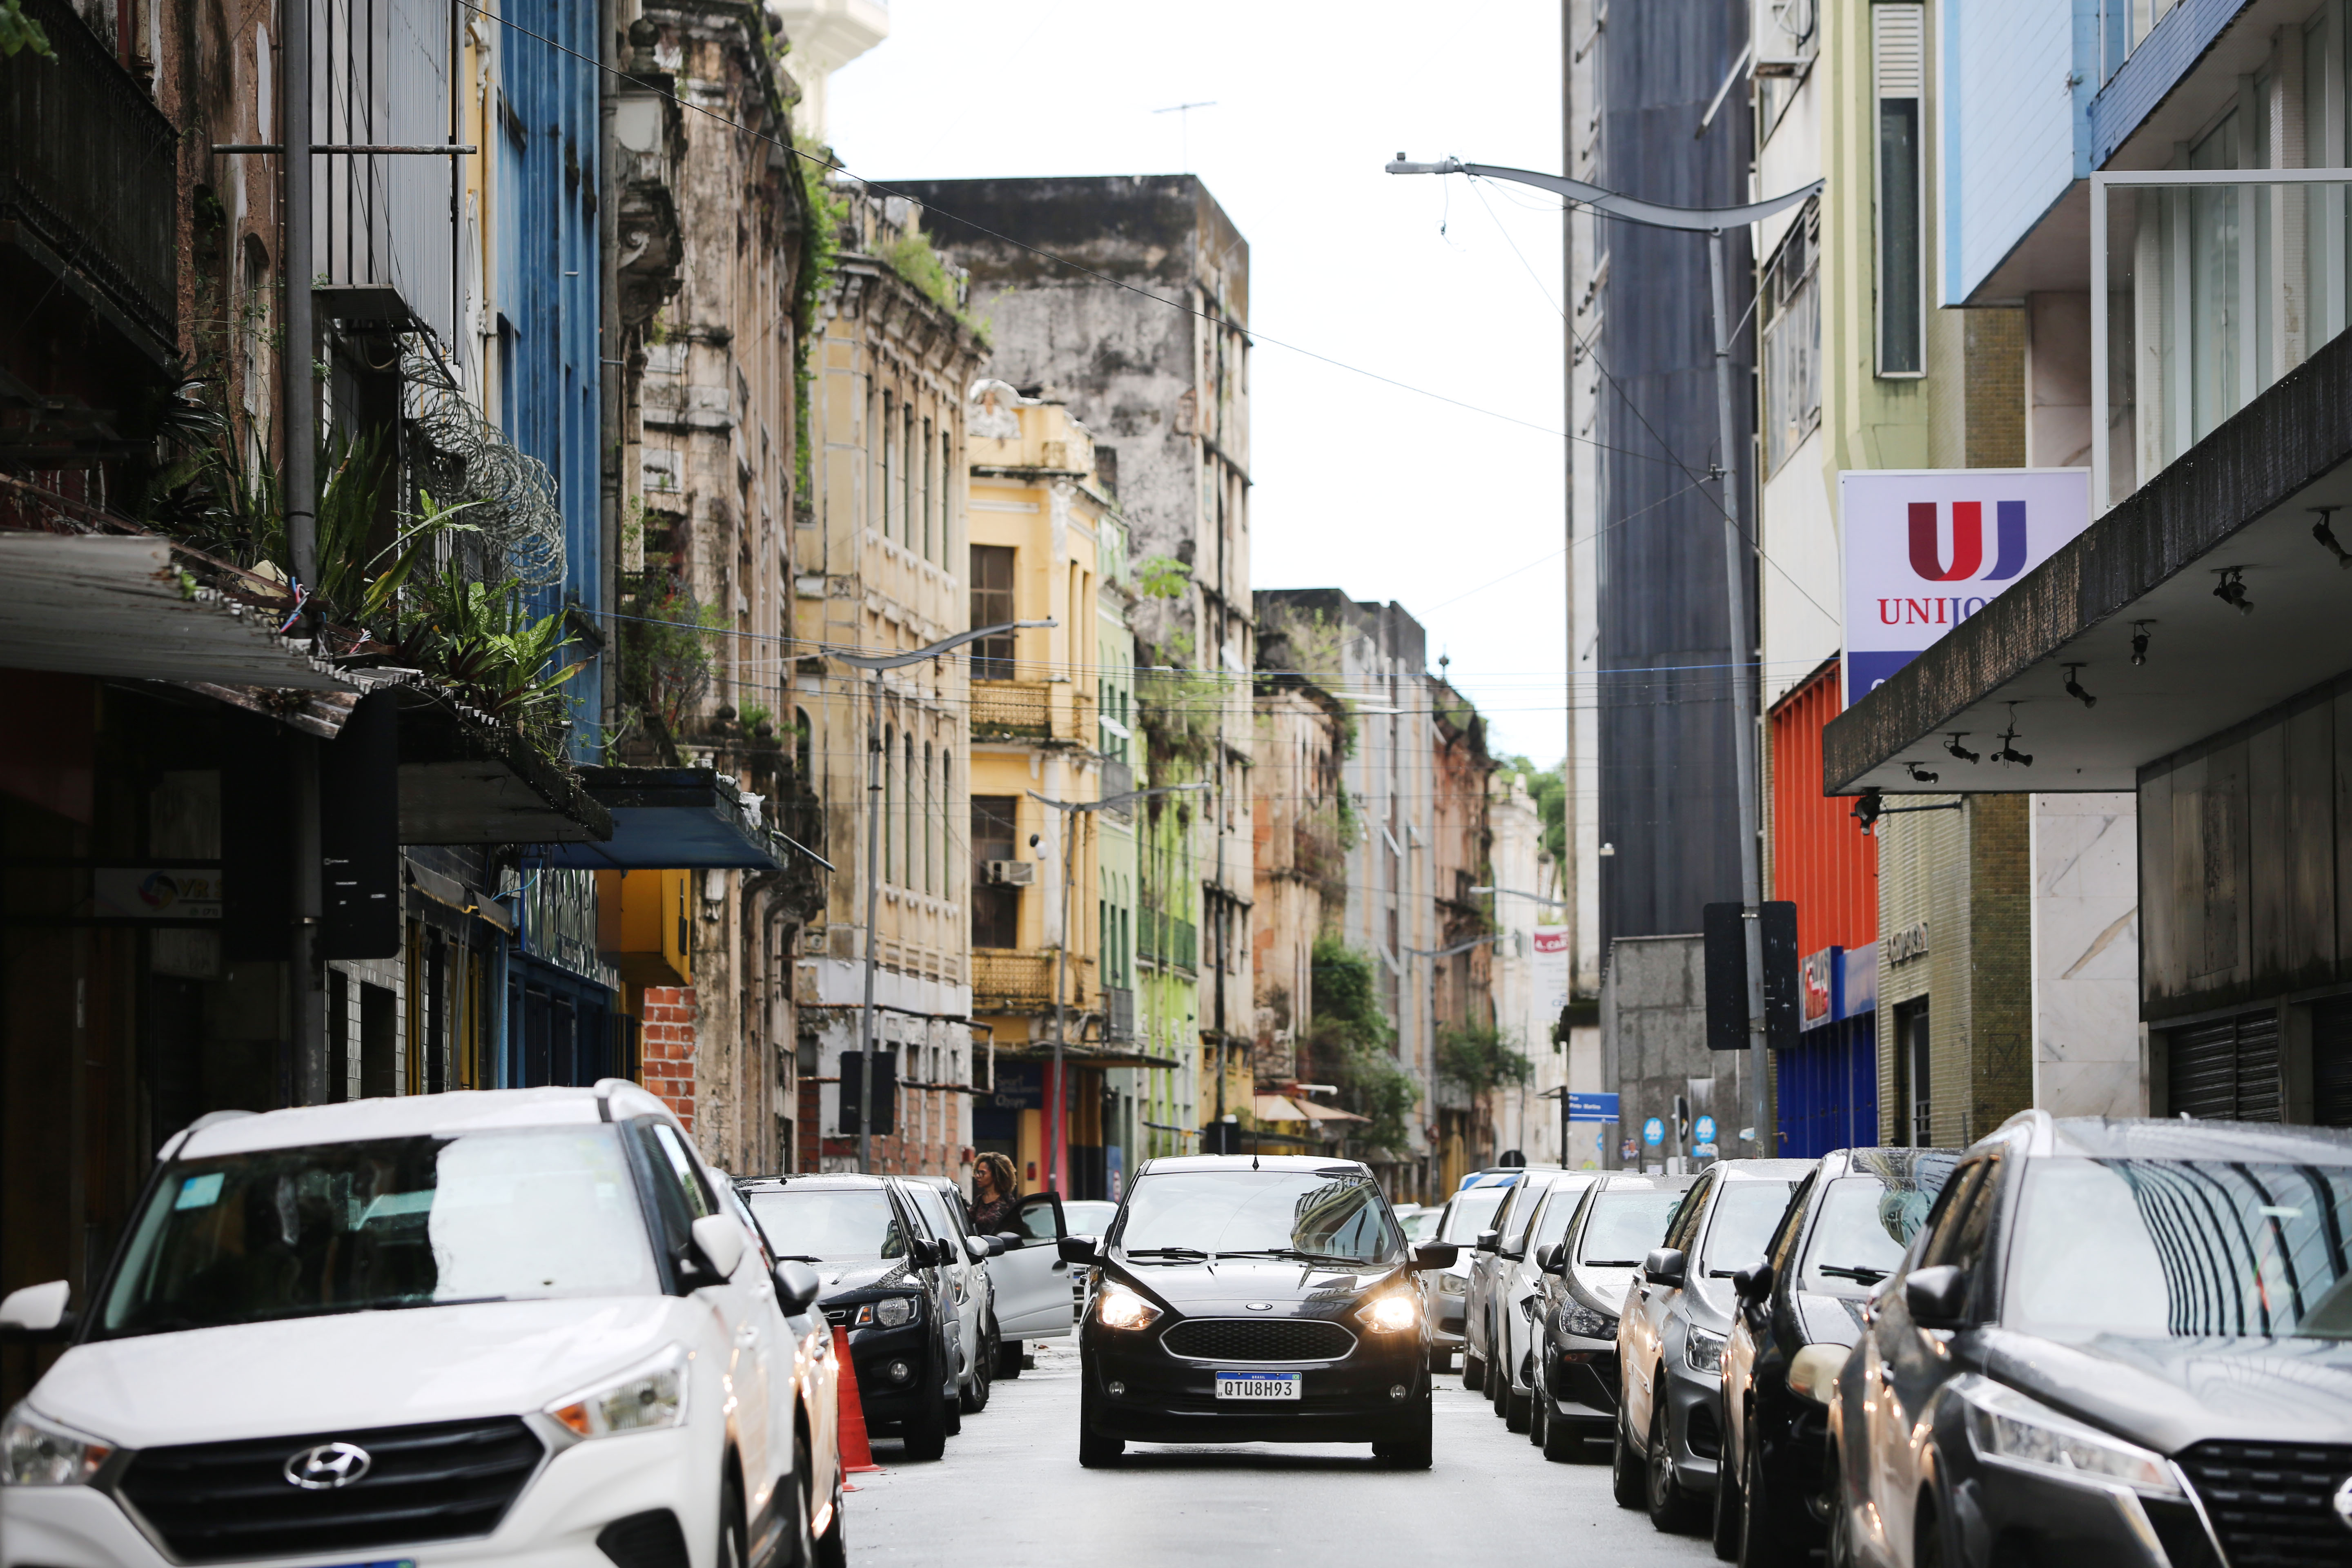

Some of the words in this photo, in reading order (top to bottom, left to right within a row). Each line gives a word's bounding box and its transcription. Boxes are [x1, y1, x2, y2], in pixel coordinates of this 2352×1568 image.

[1877, 597, 1996, 632] UNIJO
[177, 878, 209, 898] VR
[1645, 1120, 1662, 1136] 44
[1697, 1118, 1714, 1134] 44
[1225, 1381, 1292, 1396] QTU8H93
